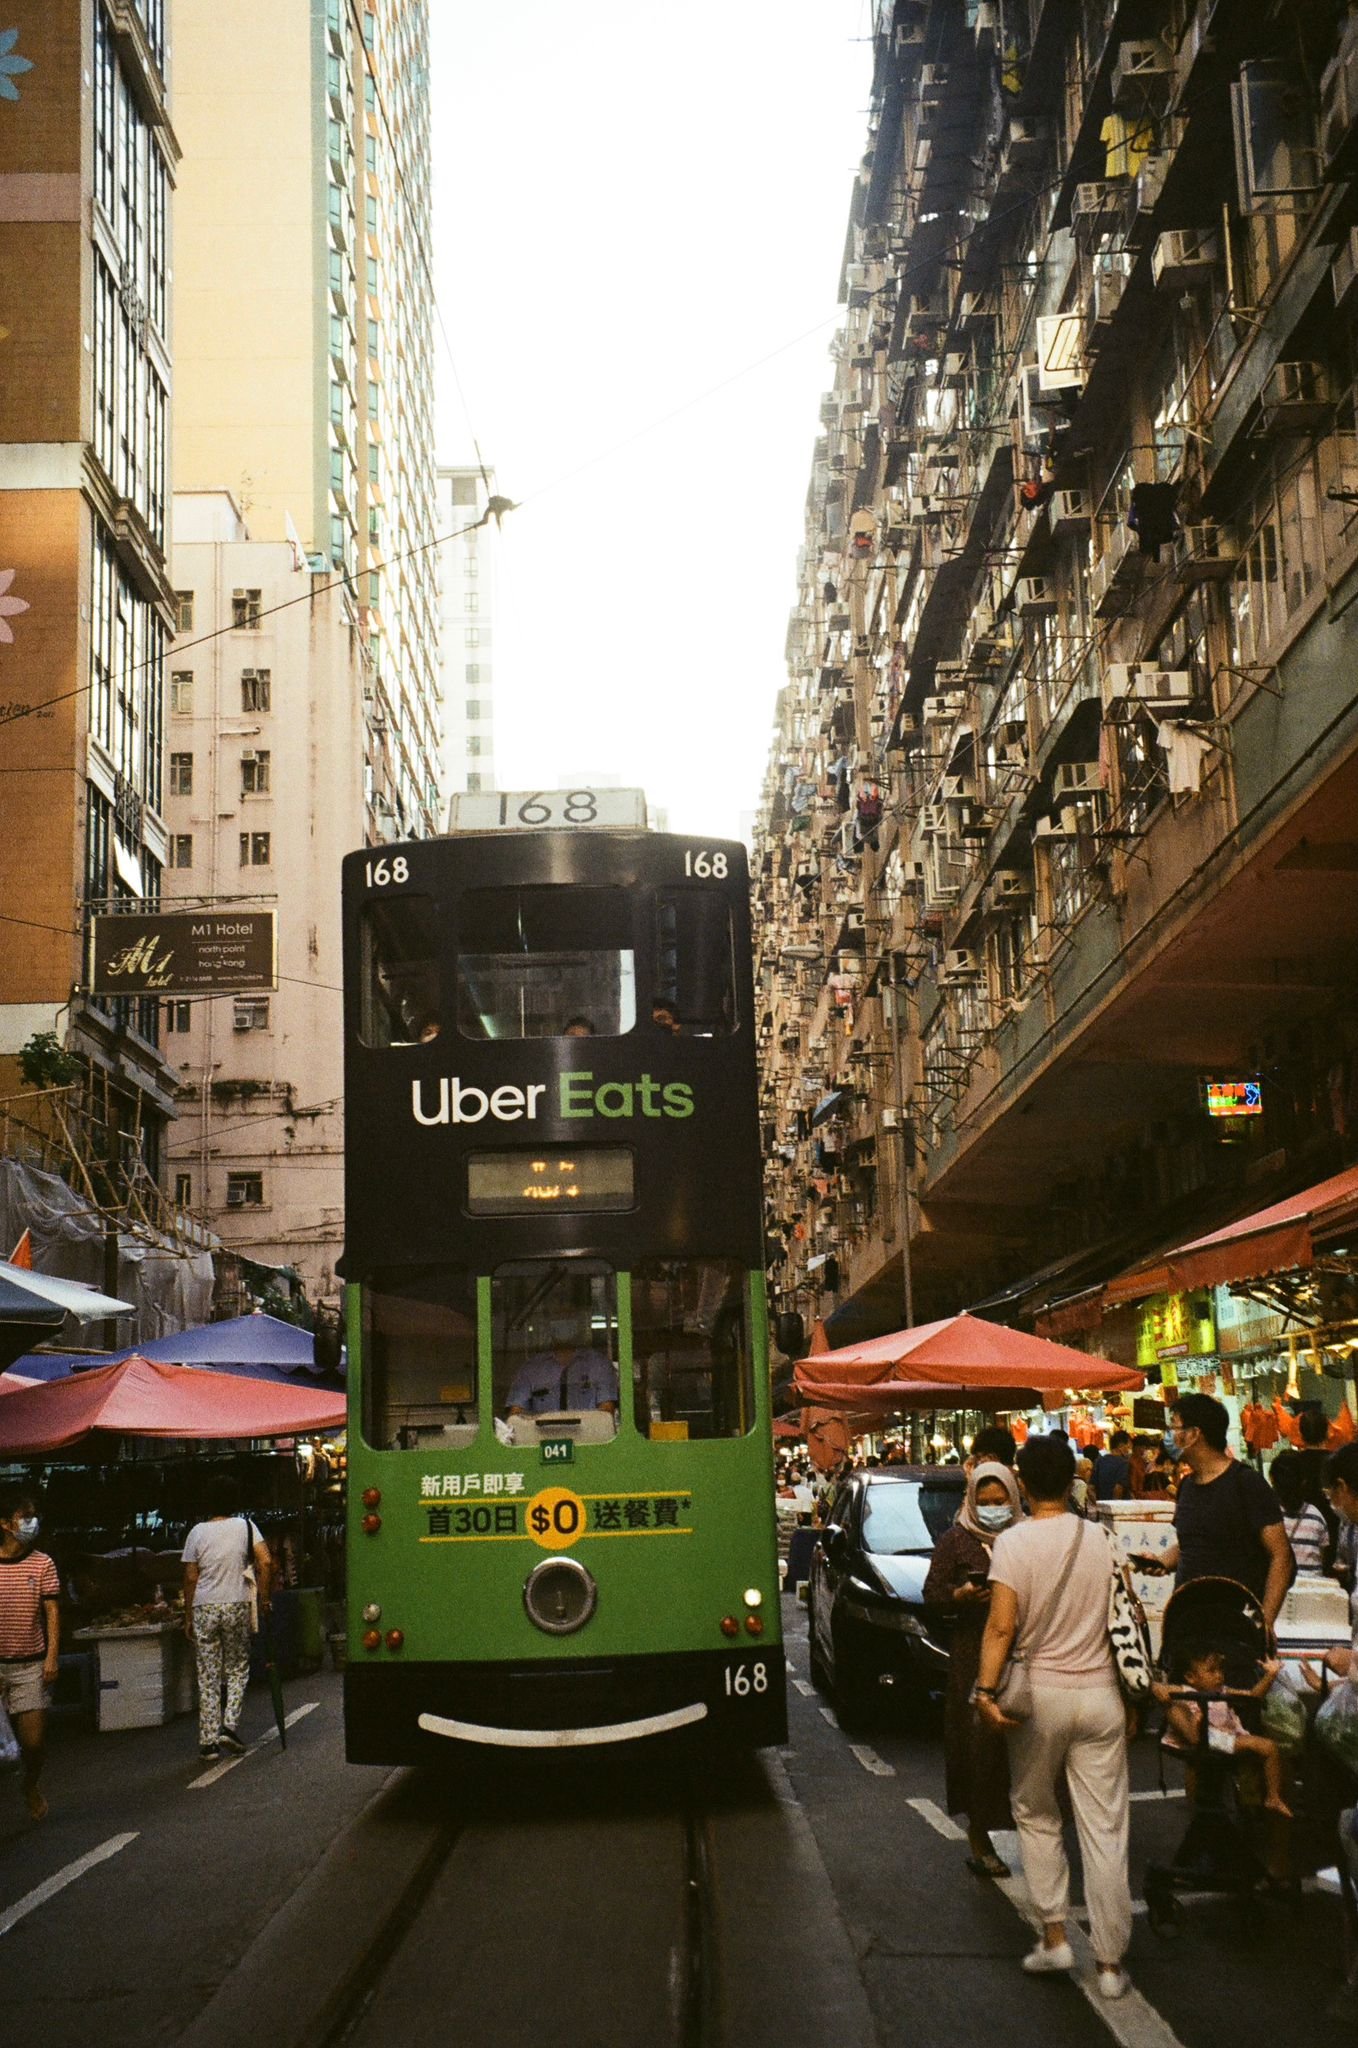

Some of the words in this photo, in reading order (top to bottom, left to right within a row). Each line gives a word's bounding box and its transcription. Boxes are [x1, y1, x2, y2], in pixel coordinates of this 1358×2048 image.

[499, 791, 598, 826] 168
[365, 856, 410, 888] 168
[685, 850, 729, 879] 168
[191, 924, 212, 936] M1
[216, 923, 254, 935] Hotel
[198, 946, 221, 954] north
[222, 945, 247, 954] point
[411, 1077, 547, 1126] Uber
[559, 1071, 696, 1118] Eats
[544, 1443, 567, 1459] 041
[421, 1472, 525, 1497] 新用戶即享
[427, 1505, 518, 1536] 首30日
[531, 1499, 580, 1535] $0
[724, 1662, 768, 1696] 168
